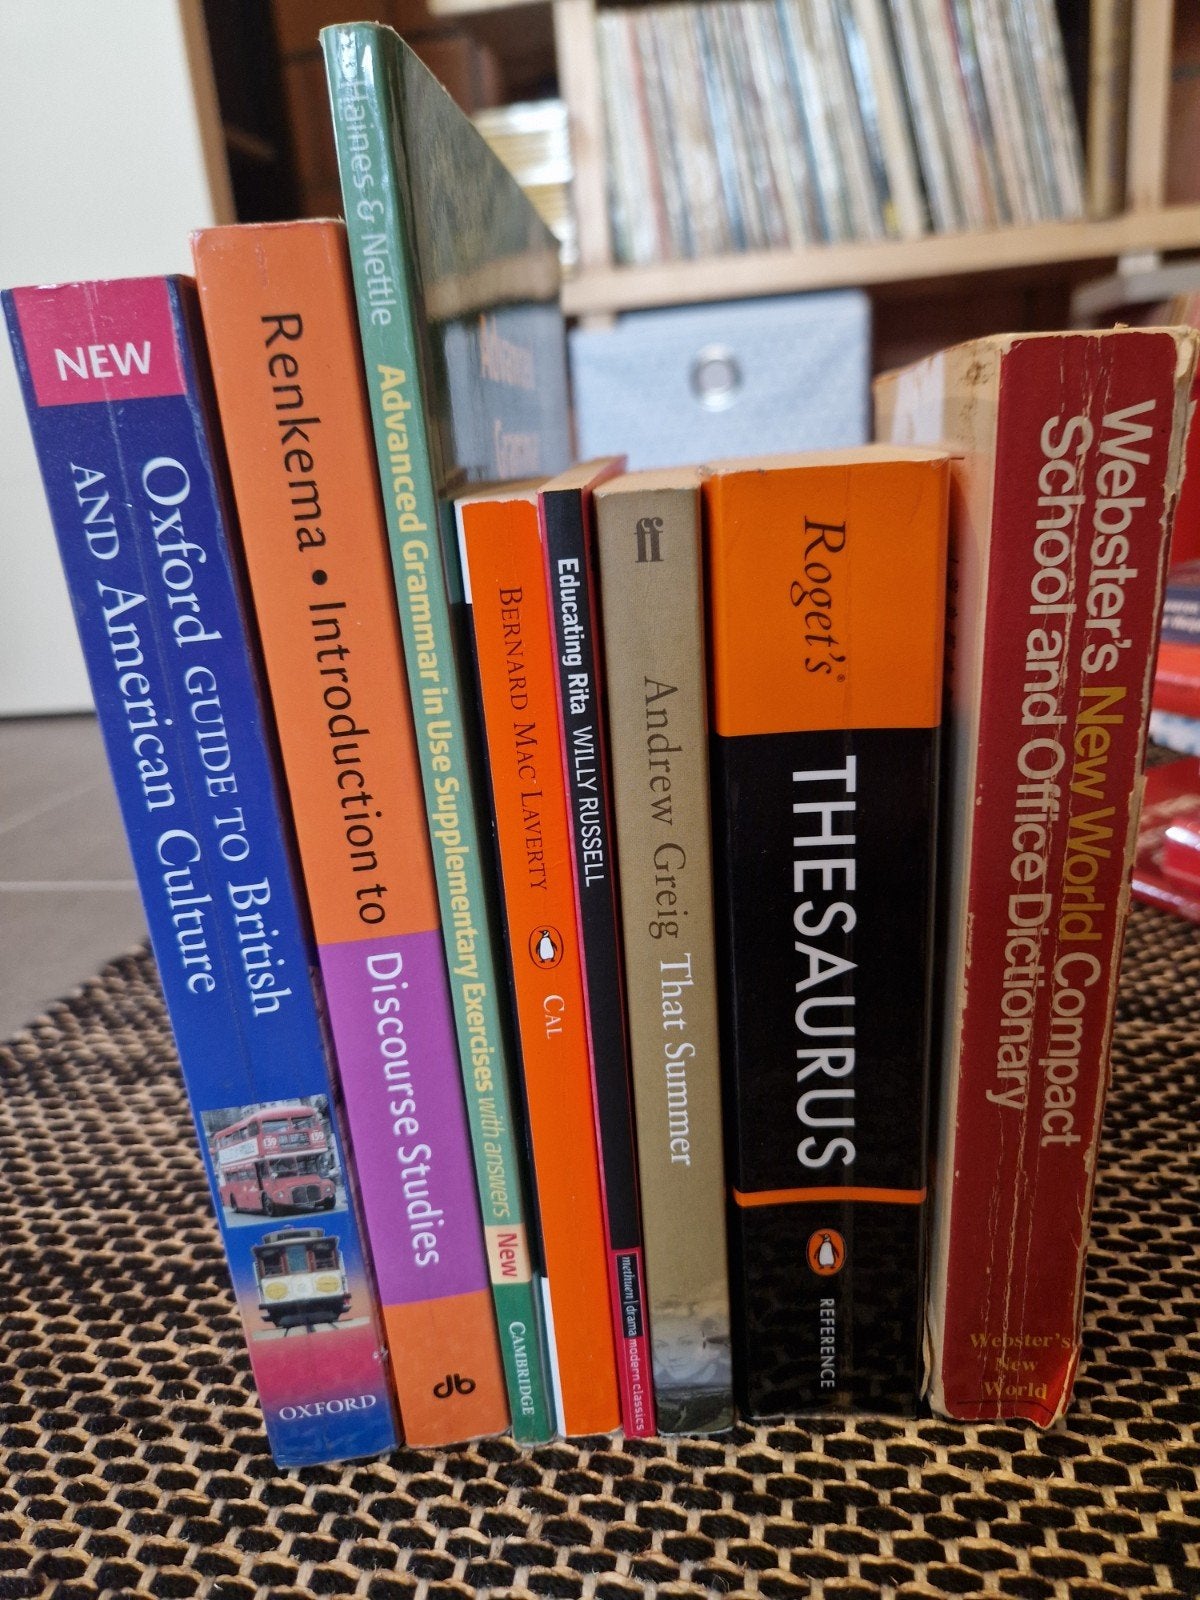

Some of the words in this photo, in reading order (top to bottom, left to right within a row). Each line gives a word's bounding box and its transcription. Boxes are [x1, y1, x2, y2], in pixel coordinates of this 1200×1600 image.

[358, 200, 385, 224] &
[361, 233, 397, 326] Nettle
[54, 341, 151, 381] NEW
[262, 313, 327, 552] Renkema
[377, 364, 428, 532] Advanced
[142, 457, 222, 647] Oxford
[1030, 415, 1094, 615] School
[1081, 399, 1156, 674] Webster's
[402, 539, 440, 682] Grammar
[557, 558, 585, 667] Educating
[422, 687, 448, 715] in
[567, 673, 589, 715] Rita
[1022, 629, 1067, 726] and
[70, 462, 120, 560] AND
[97, 580, 175, 812] American
[156, 829, 215, 994] Culture
[184, 666, 238, 798] GUIDE
[309, 601, 382, 872] Introduction
[427, 720, 453, 772] Use
[500, 586, 528, 711] BERNARD
[521, 790, 547, 891] LAVERTY
[572, 726, 598, 792] WILLY
[643, 676, 682, 826] Andrew
[1070, 686, 1127, 799] New
[213, 807, 250, 862] TO
[578, 797, 605, 888] RUSSELL
[1010, 737, 1066, 882] Office
[357, 883, 388, 924] to
[432, 776, 479, 978] Supplementary
[649, 843, 689, 939] Greig
[1057, 806, 1115, 941] World
[227, 877, 293, 1017] British
[659, 952, 694, 1031] That
[793, 755, 858, 1169] THESAURUS
[366, 952, 419, 1137] Discourse
[462, 983, 495, 1093] Exercises
[543, 994, 565, 1039] CAL
[985, 893, 1052, 1111] Dictionary
[1038, 951, 1101, 1147] Compact
[478, 1097, 505, 1139] with
[663, 1039, 696, 1167] Summer
[398, 1143, 445, 1268] Studies
[484, 1141, 510, 1218] answers
[497, 1233, 518, 1277] New
[622, 1256, 635, 1300] methuen
[509, 1321, 535, 1416] CAMBRIDGE
[626, 1305, 638, 1336] drama
[627, 1338, 641, 1380] modern
[820, 1298, 836, 1388] REFERENCE
[970, 1333, 1072, 1349] Webster's
[995, 1357, 1038, 1372] New
[278, 1394, 377, 1421] OXFORD
[632, 1382, 645, 1431] classics
[984, 1381, 1047, 1400] World
